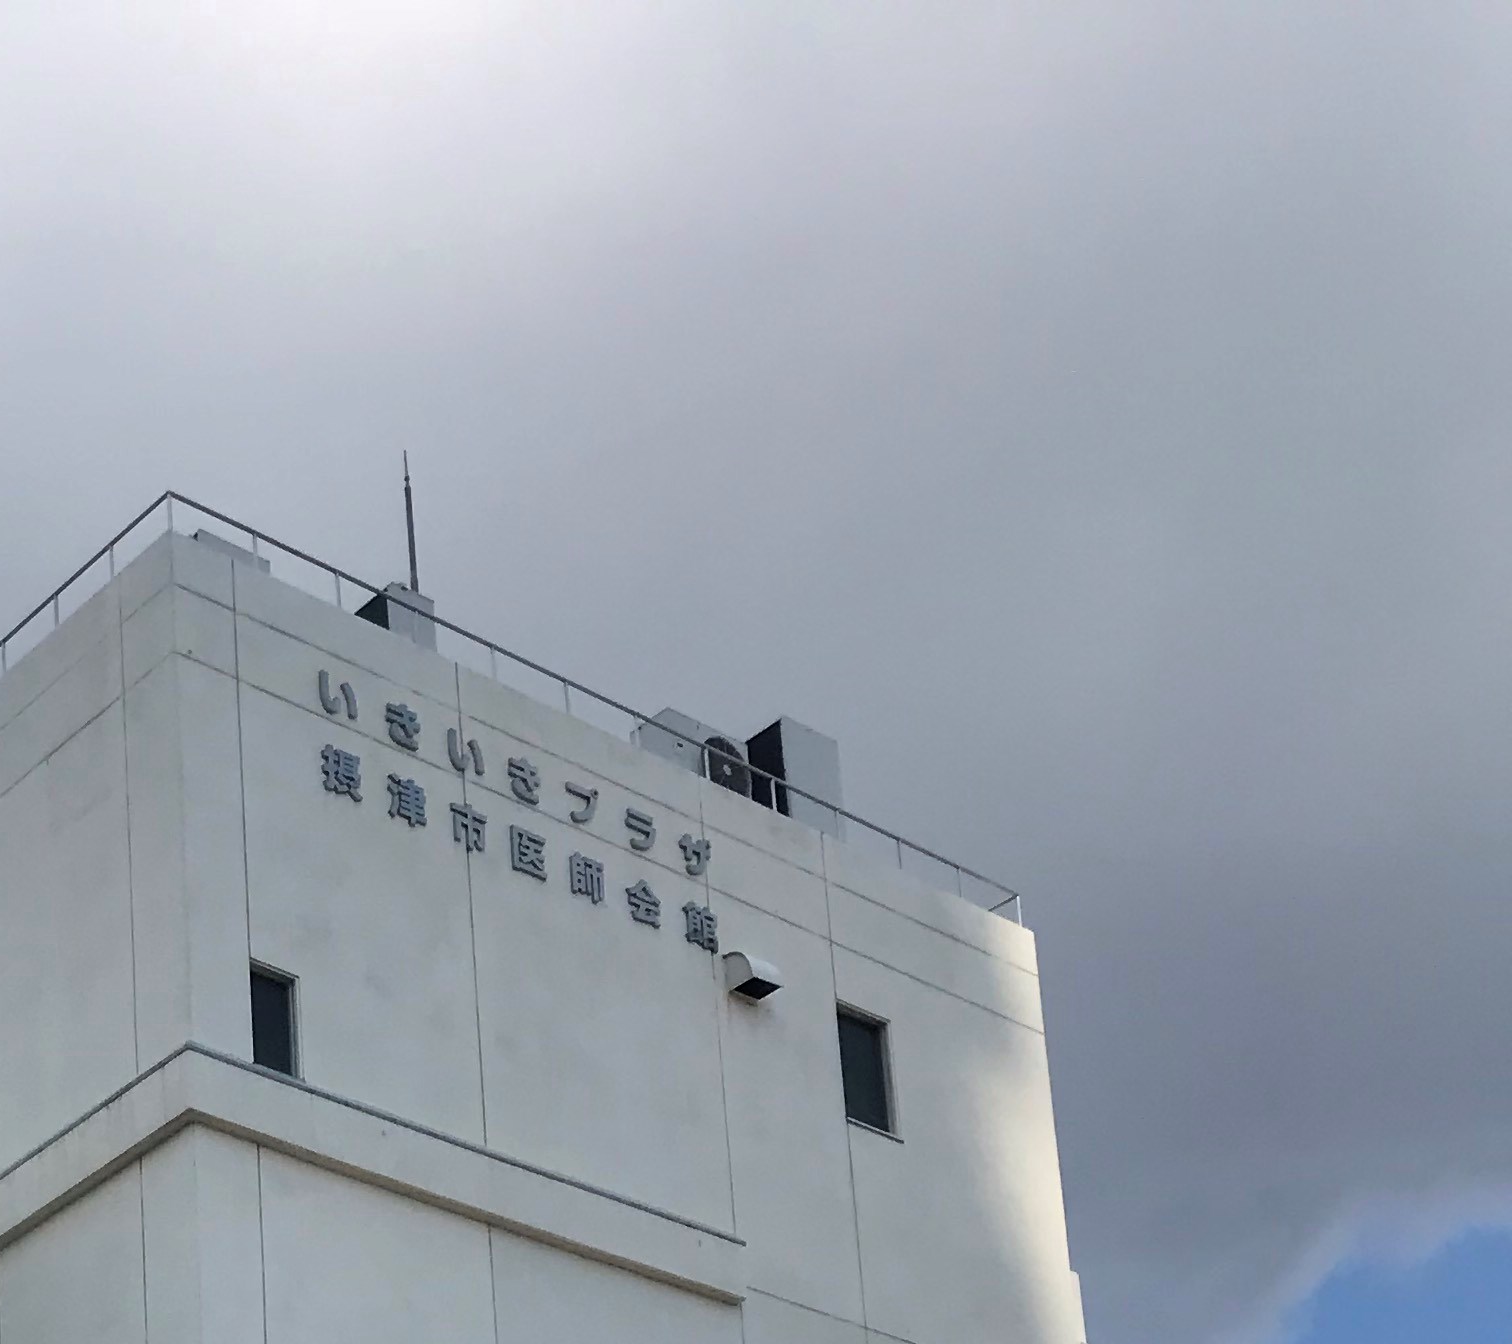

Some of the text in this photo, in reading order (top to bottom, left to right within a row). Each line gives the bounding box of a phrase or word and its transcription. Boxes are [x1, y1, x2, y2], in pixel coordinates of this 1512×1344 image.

[318, 669, 712, 876] いきいきプラザ
[321, 744, 719, 953] 摂津市医師会館
